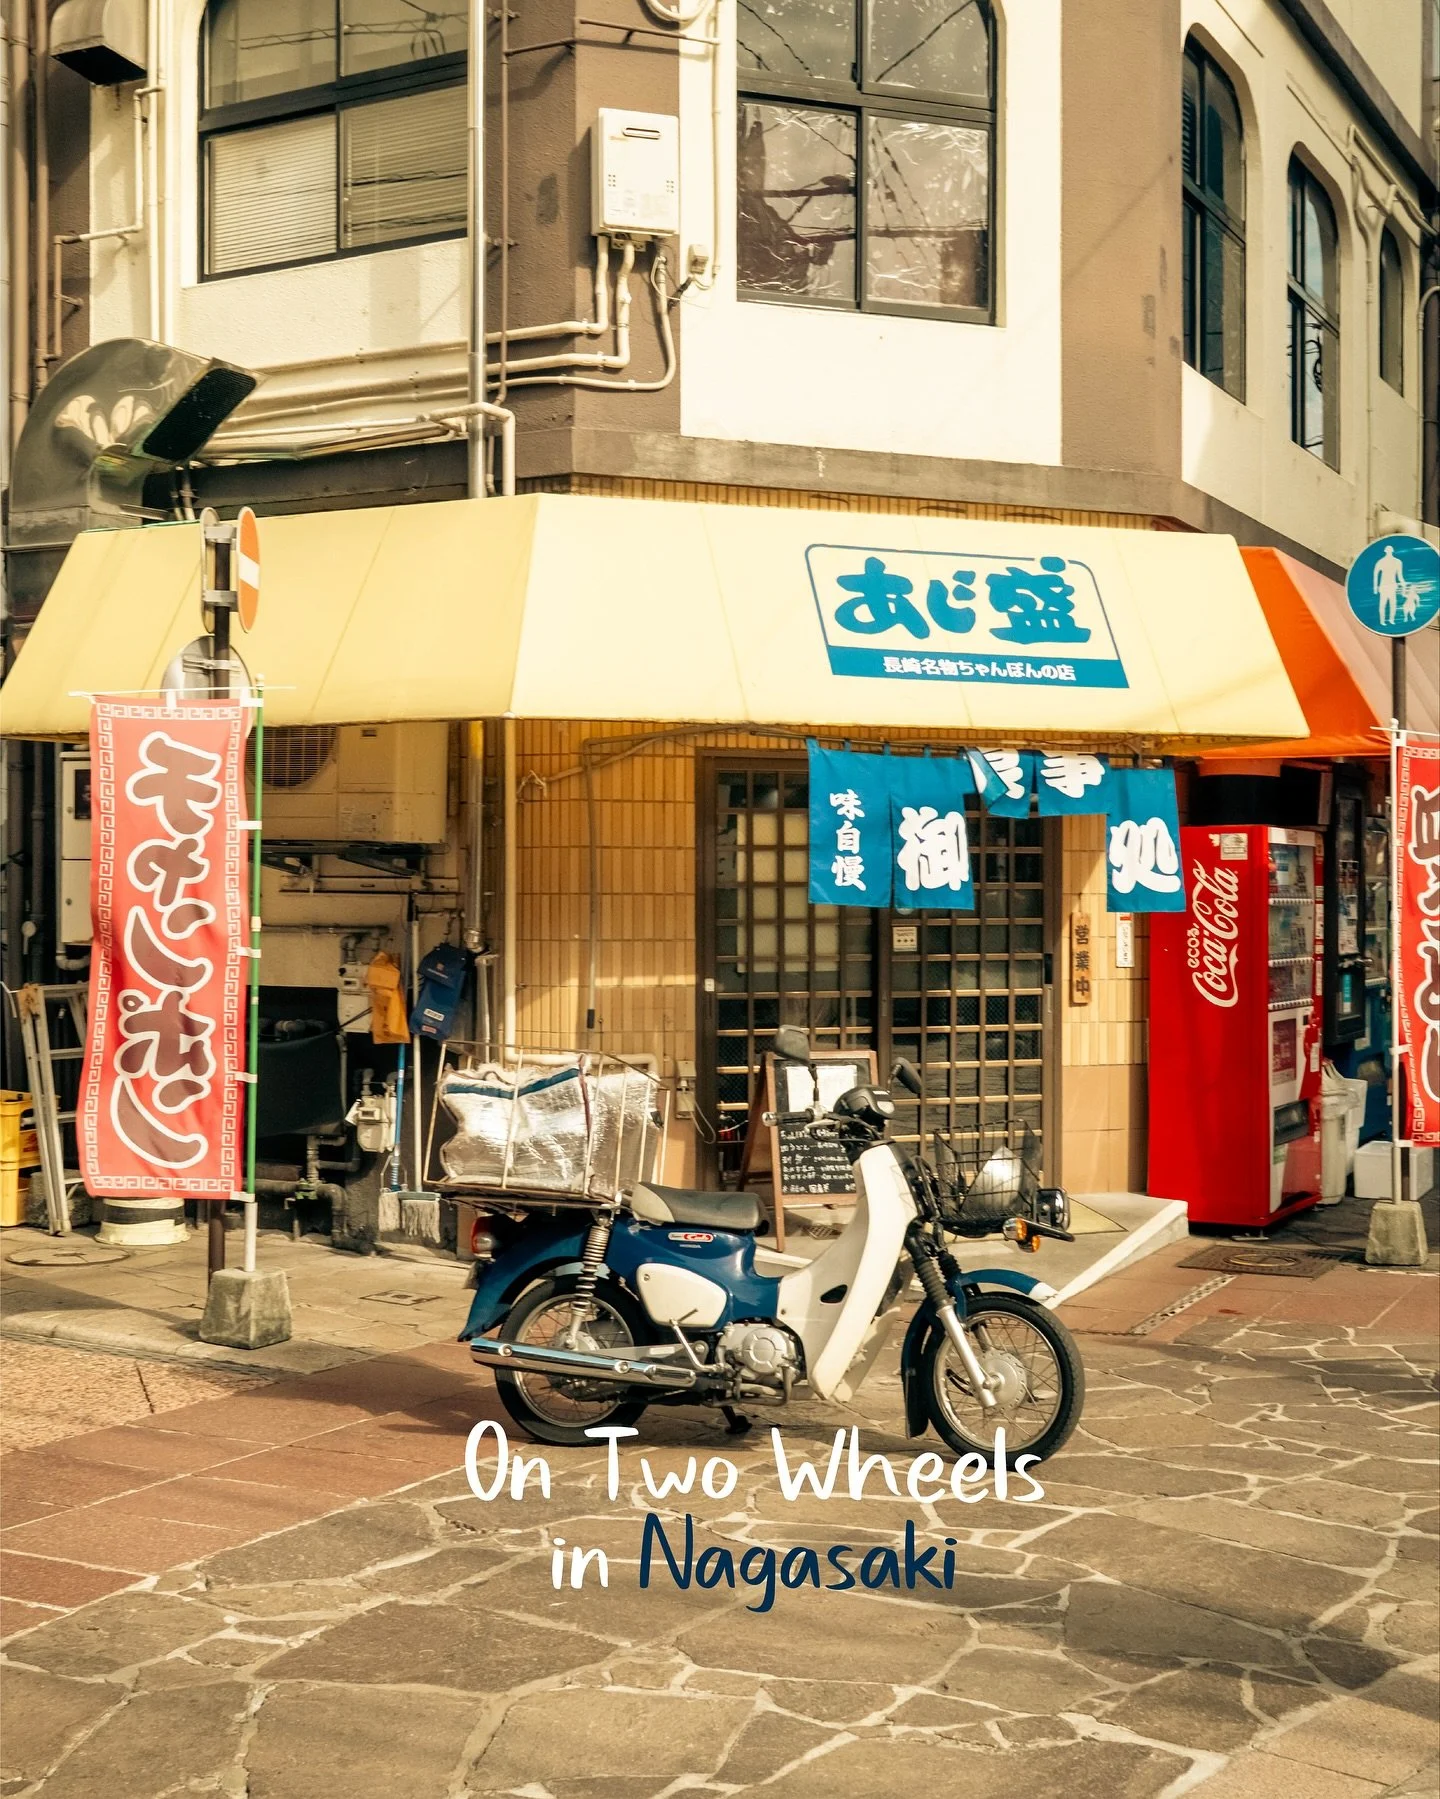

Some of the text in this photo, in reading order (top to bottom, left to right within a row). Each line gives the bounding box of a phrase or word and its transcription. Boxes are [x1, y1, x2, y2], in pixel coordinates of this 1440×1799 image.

[834, 556, 1092, 645] あじ盛
[828, 788, 867, 892] 味自慢
[1074, 924, 1090, 996] 営業中
[1192, 858, 1239, 1008] Coca-Cola
